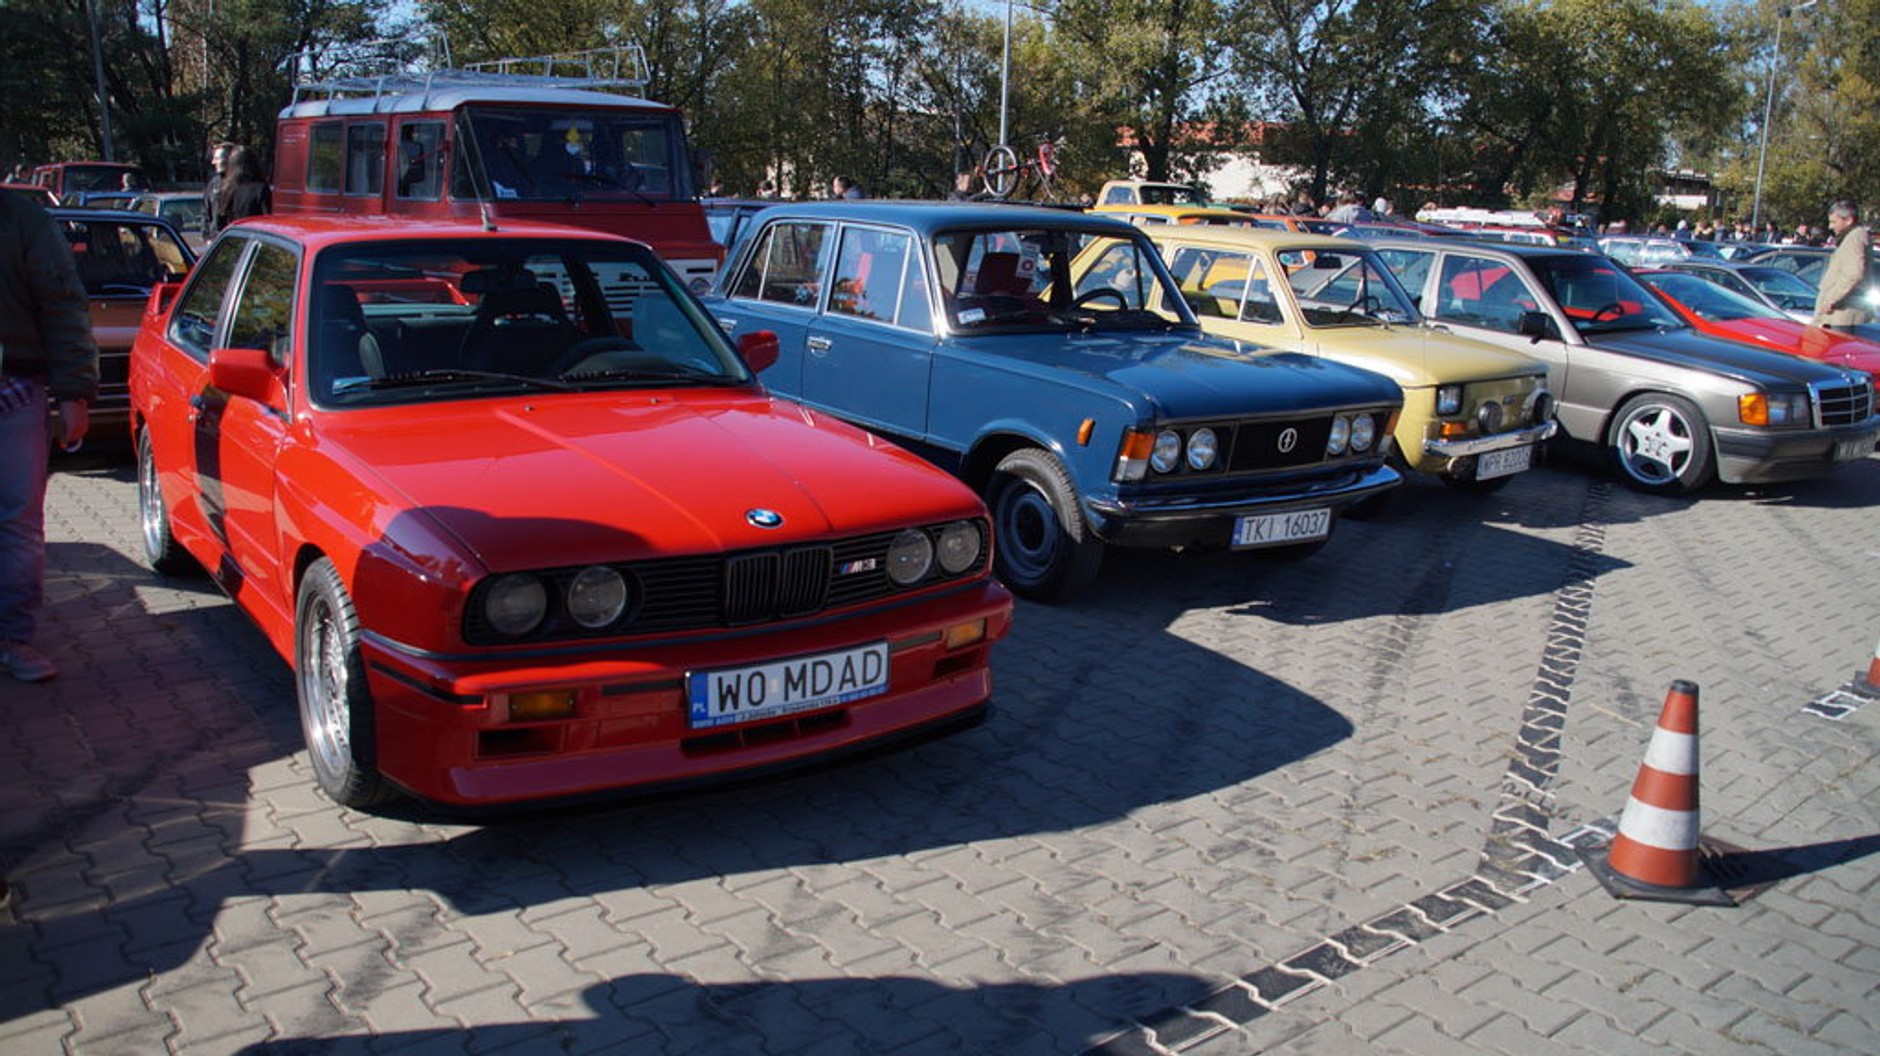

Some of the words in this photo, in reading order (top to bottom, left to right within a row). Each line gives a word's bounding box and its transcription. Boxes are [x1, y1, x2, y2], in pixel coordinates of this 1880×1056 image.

[1246, 517, 1274, 541] TKI
[1285, 511, 1329, 538] 16037
[717, 671, 766, 713] WO
[784, 650, 883, 702] MDAD
[692, 702, 706, 713] PL
